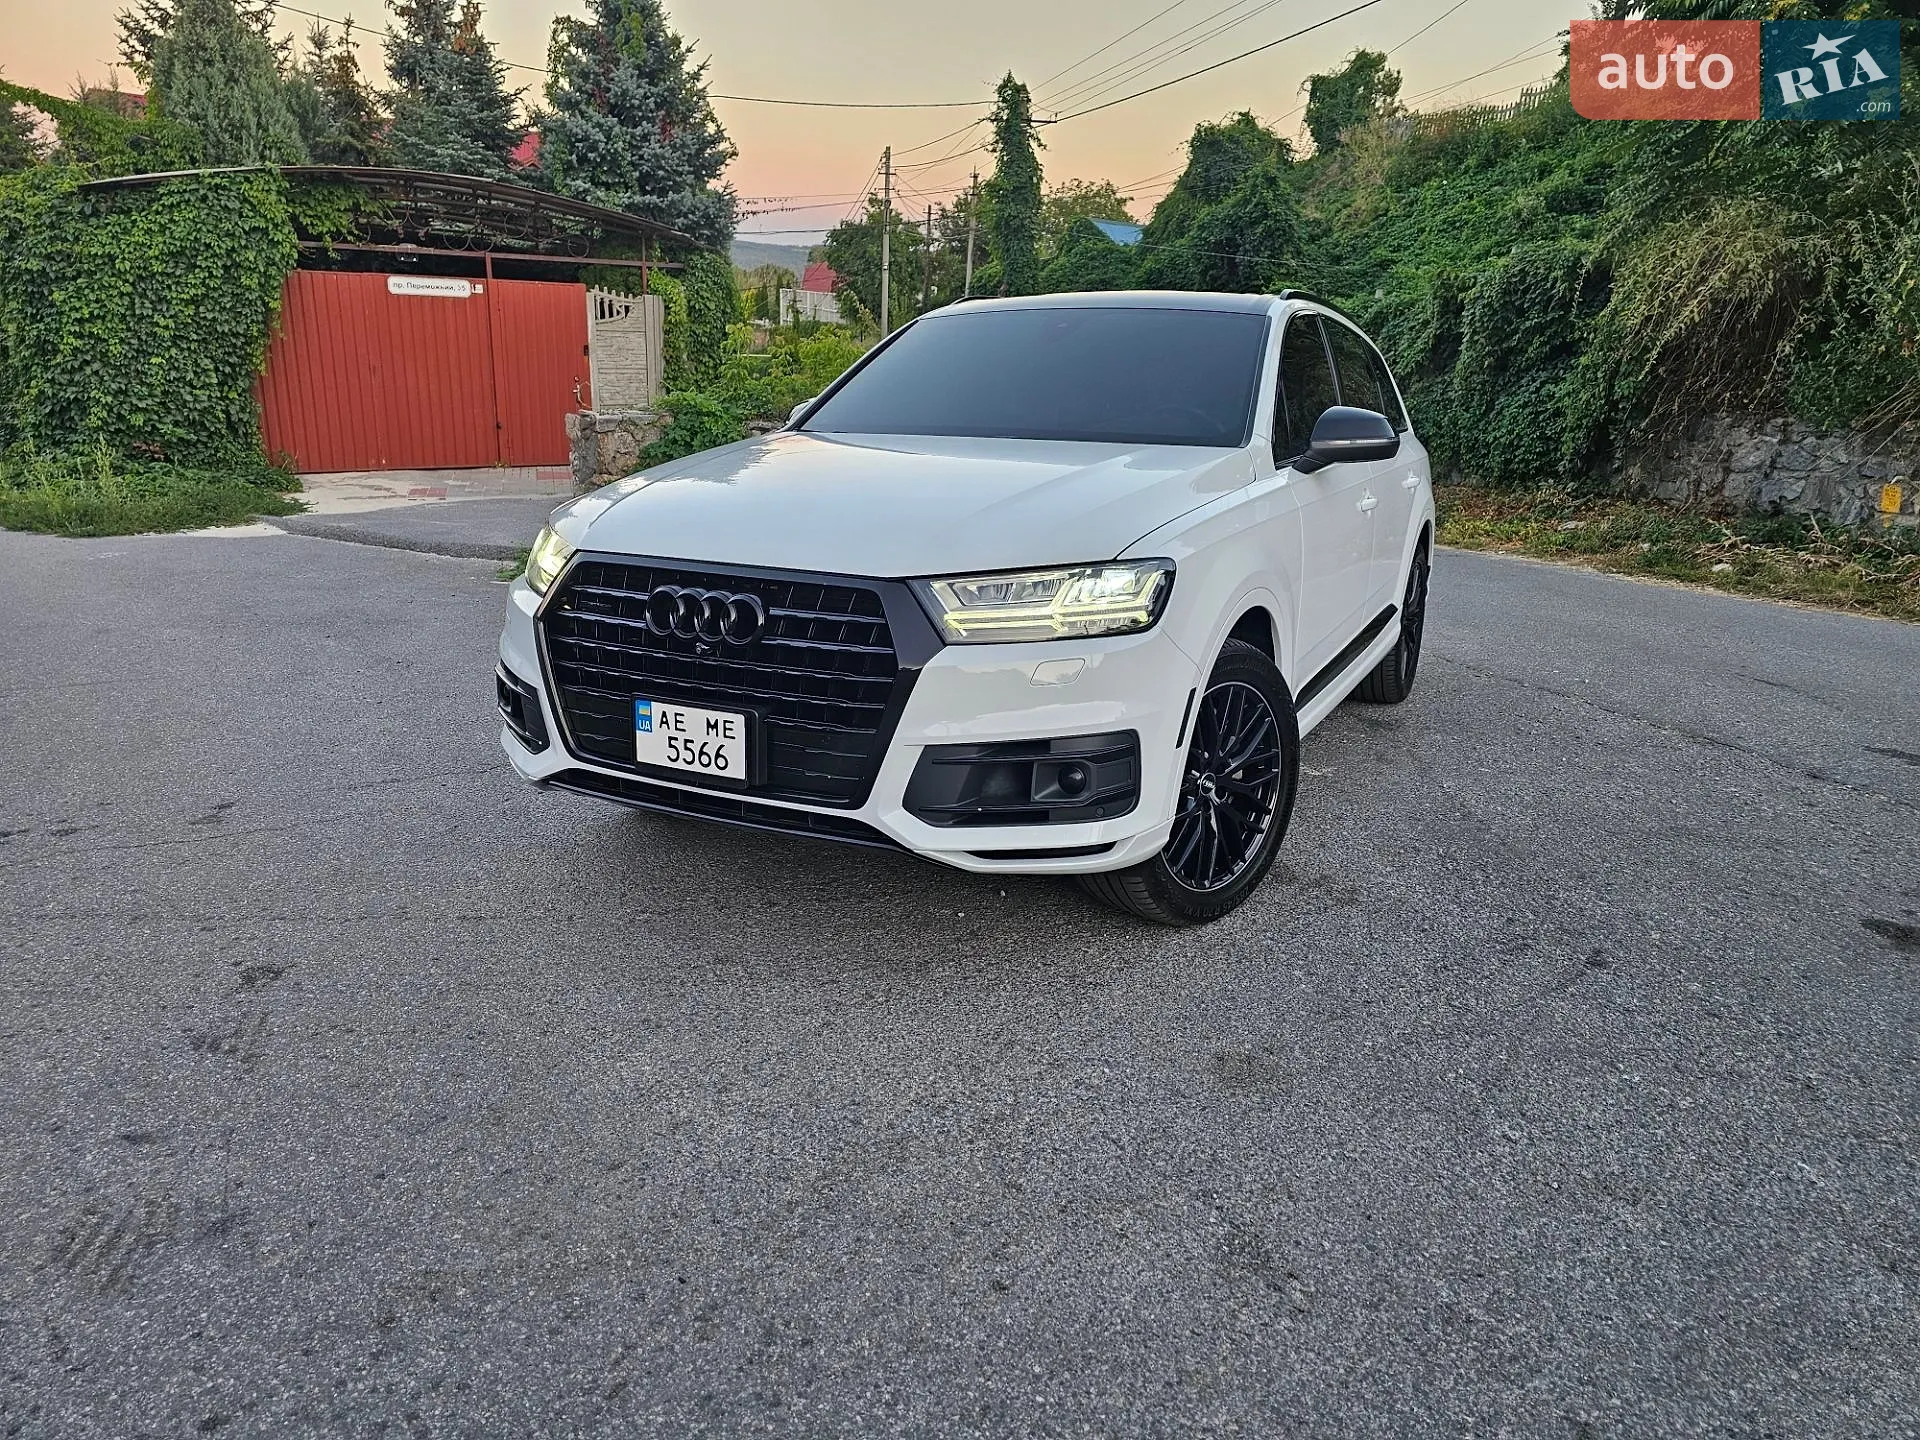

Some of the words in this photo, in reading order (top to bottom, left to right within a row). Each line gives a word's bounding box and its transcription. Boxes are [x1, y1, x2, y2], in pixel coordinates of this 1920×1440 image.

[639, 719, 651, 732] UA
[659, 710, 687, 732] AE
[705, 716, 736, 740] ME
[666, 735, 729, 771] 5566
